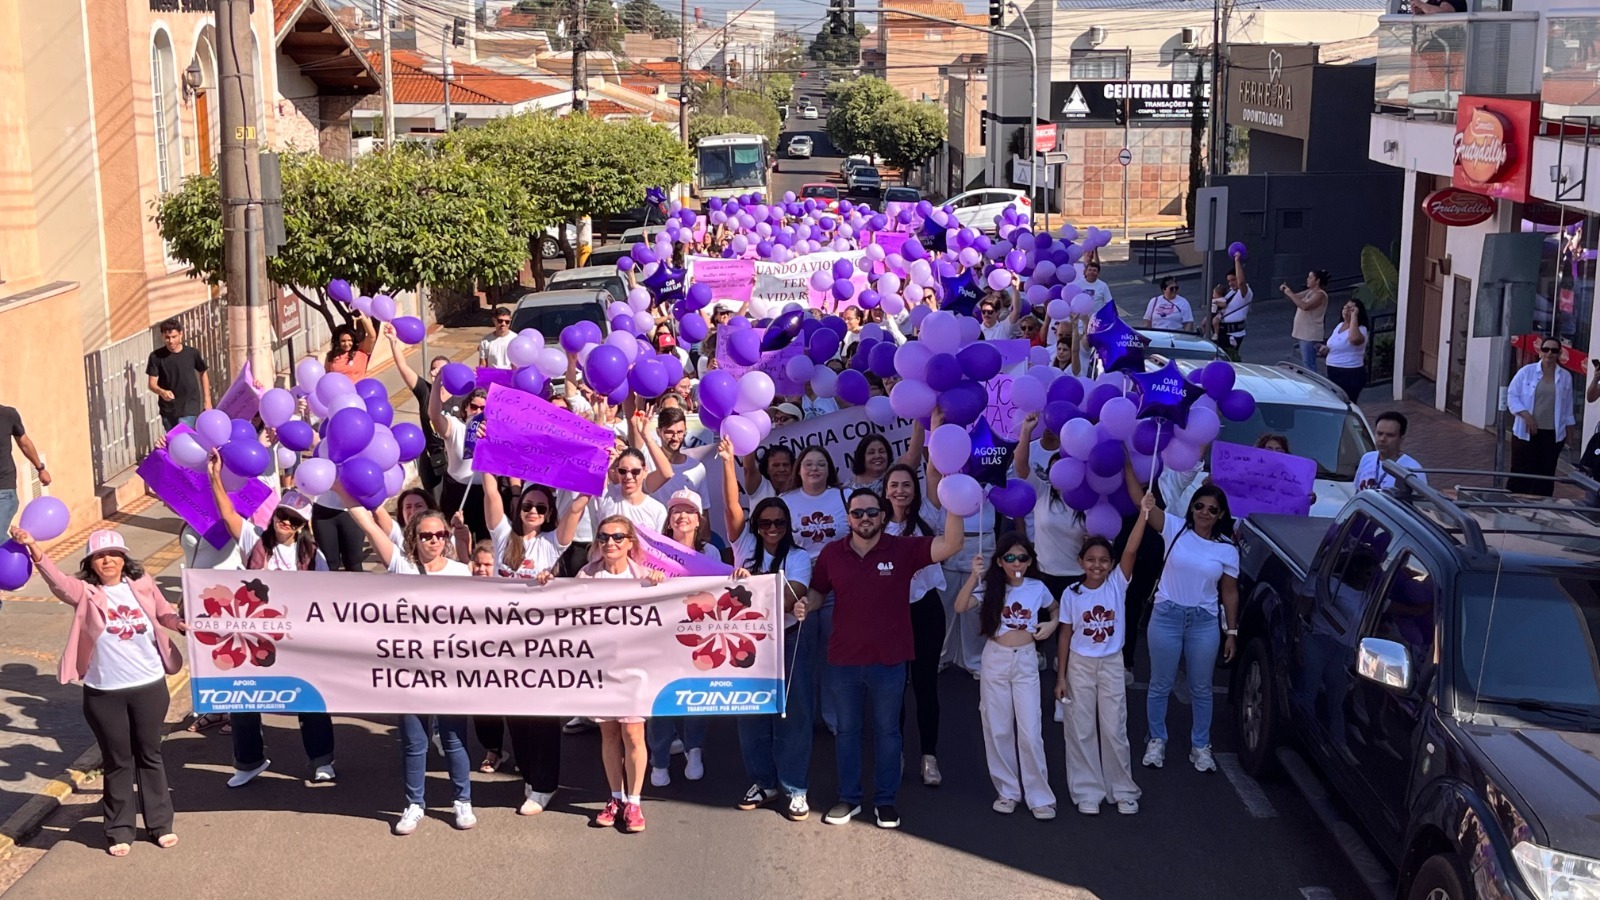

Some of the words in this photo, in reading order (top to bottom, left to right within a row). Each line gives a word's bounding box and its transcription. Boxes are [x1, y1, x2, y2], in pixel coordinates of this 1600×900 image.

[1103, 83, 1170, 99] CENTRAL
[1172, 84, 1191, 99] DE
[1144, 100, 1187, 109] TRANSAÇÕES
[1242, 108, 1284, 127] ODONTOLOGIA
[1453, 132, 1507, 173] Frutydellys
[1430, 200, 1492, 215] Frutydellys
[756, 263, 798, 276] UANDO
[767, 292, 796, 302] VIDA
[1163, 377, 1179, 386] OAB
[1151, 384, 1171, 393] PARA
[1171, 386, 1188, 398] ELAS
[974, 446, 1007, 455] AGOSTO
[981, 453, 1002, 465] LILÁS
[877, 561, 894, 570] OAB
[306, 602, 325, 622] A
[333, 598, 476, 624] VIOLÊNCIA
[485, 602, 545, 625] NÃO
[554, 605, 662, 626] PRECISA
[194, 621, 220, 630] OAB
[225, 621, 256, 630] PARA
[262, 621, 293, 630] ELAS
[708, 623, 739, 631] PARA
[745, 622, 774, 631] ELAS
[377, 639, 424, 659] SER
[434, 634, 516, 659] FÍSICA
[525, 639, 595, 659] PARA
[372, 668, 447, 688] FICAR
[456, 669, 603, 689] MARCADA!
